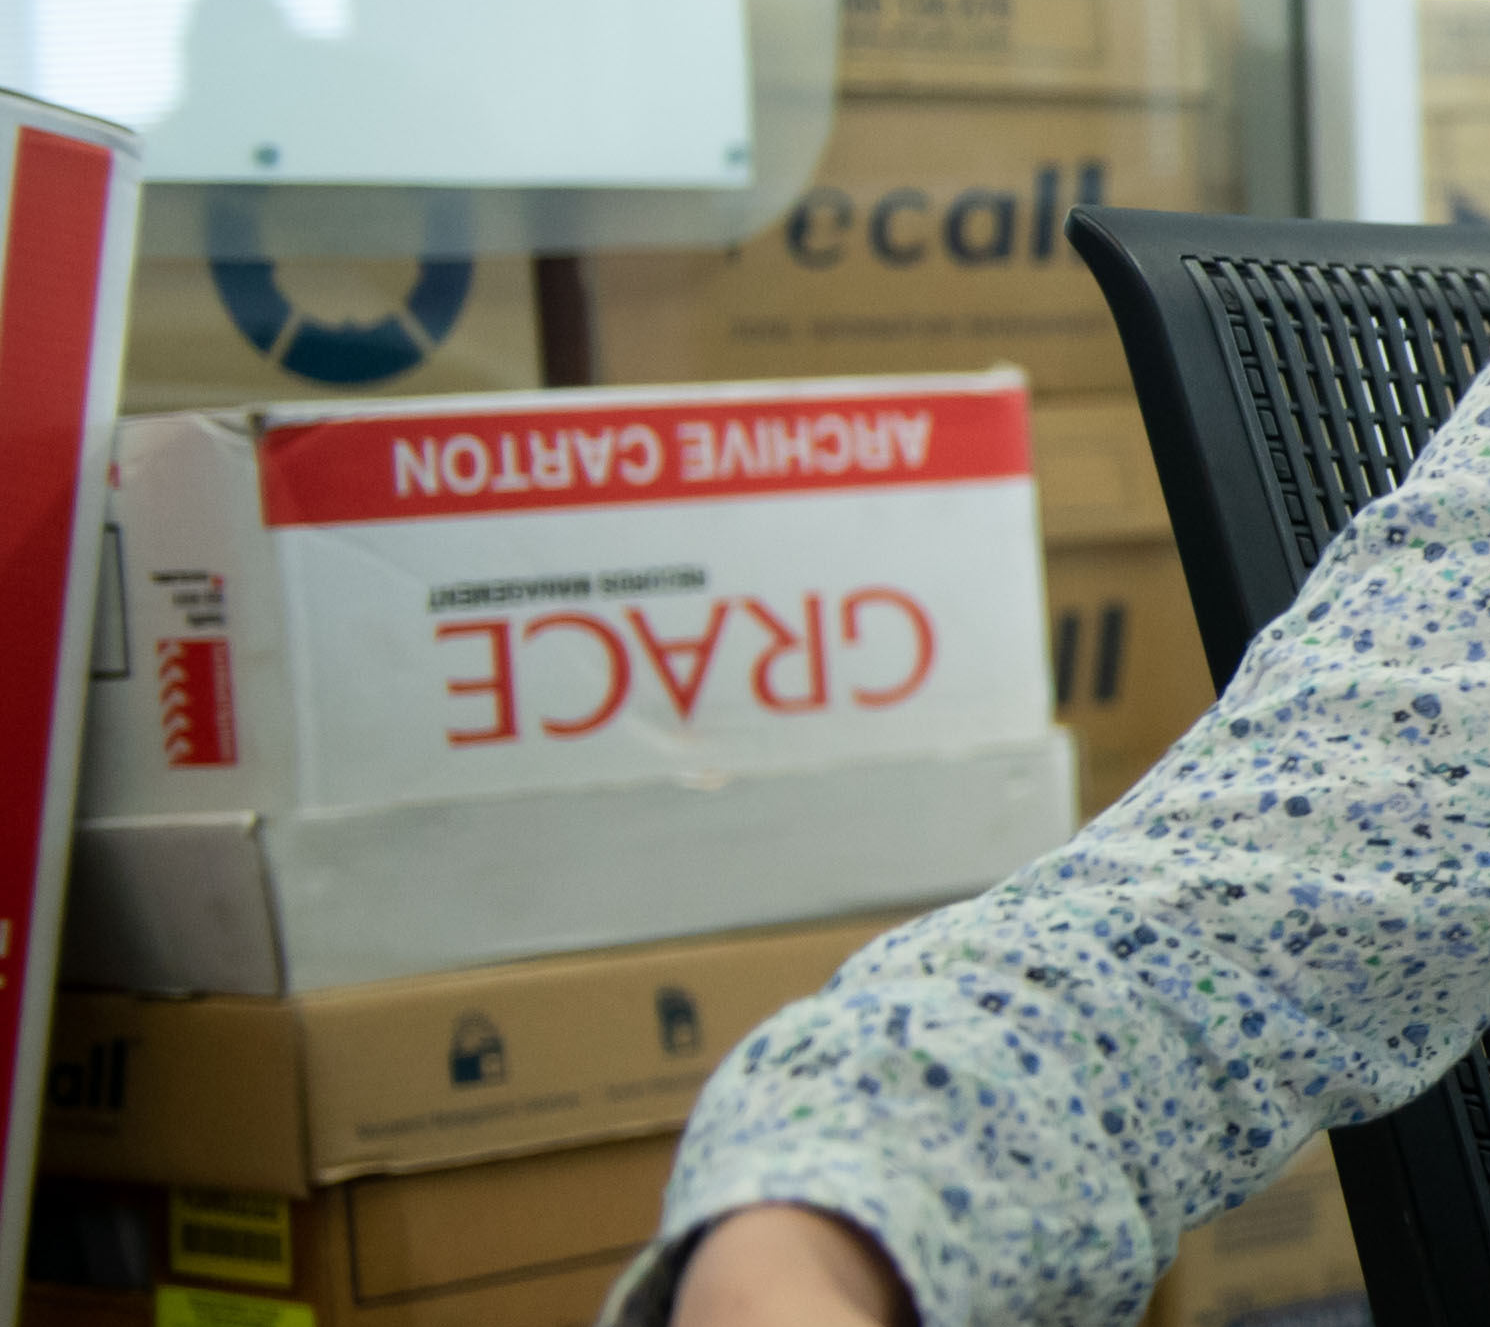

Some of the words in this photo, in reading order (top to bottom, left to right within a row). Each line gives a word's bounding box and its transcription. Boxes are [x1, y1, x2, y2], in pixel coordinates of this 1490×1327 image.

[393, 427, 664, 498] CARTON
[682, 411, 931, 479] ARCHIVE
[434, 588, 936, 747] GRACE
